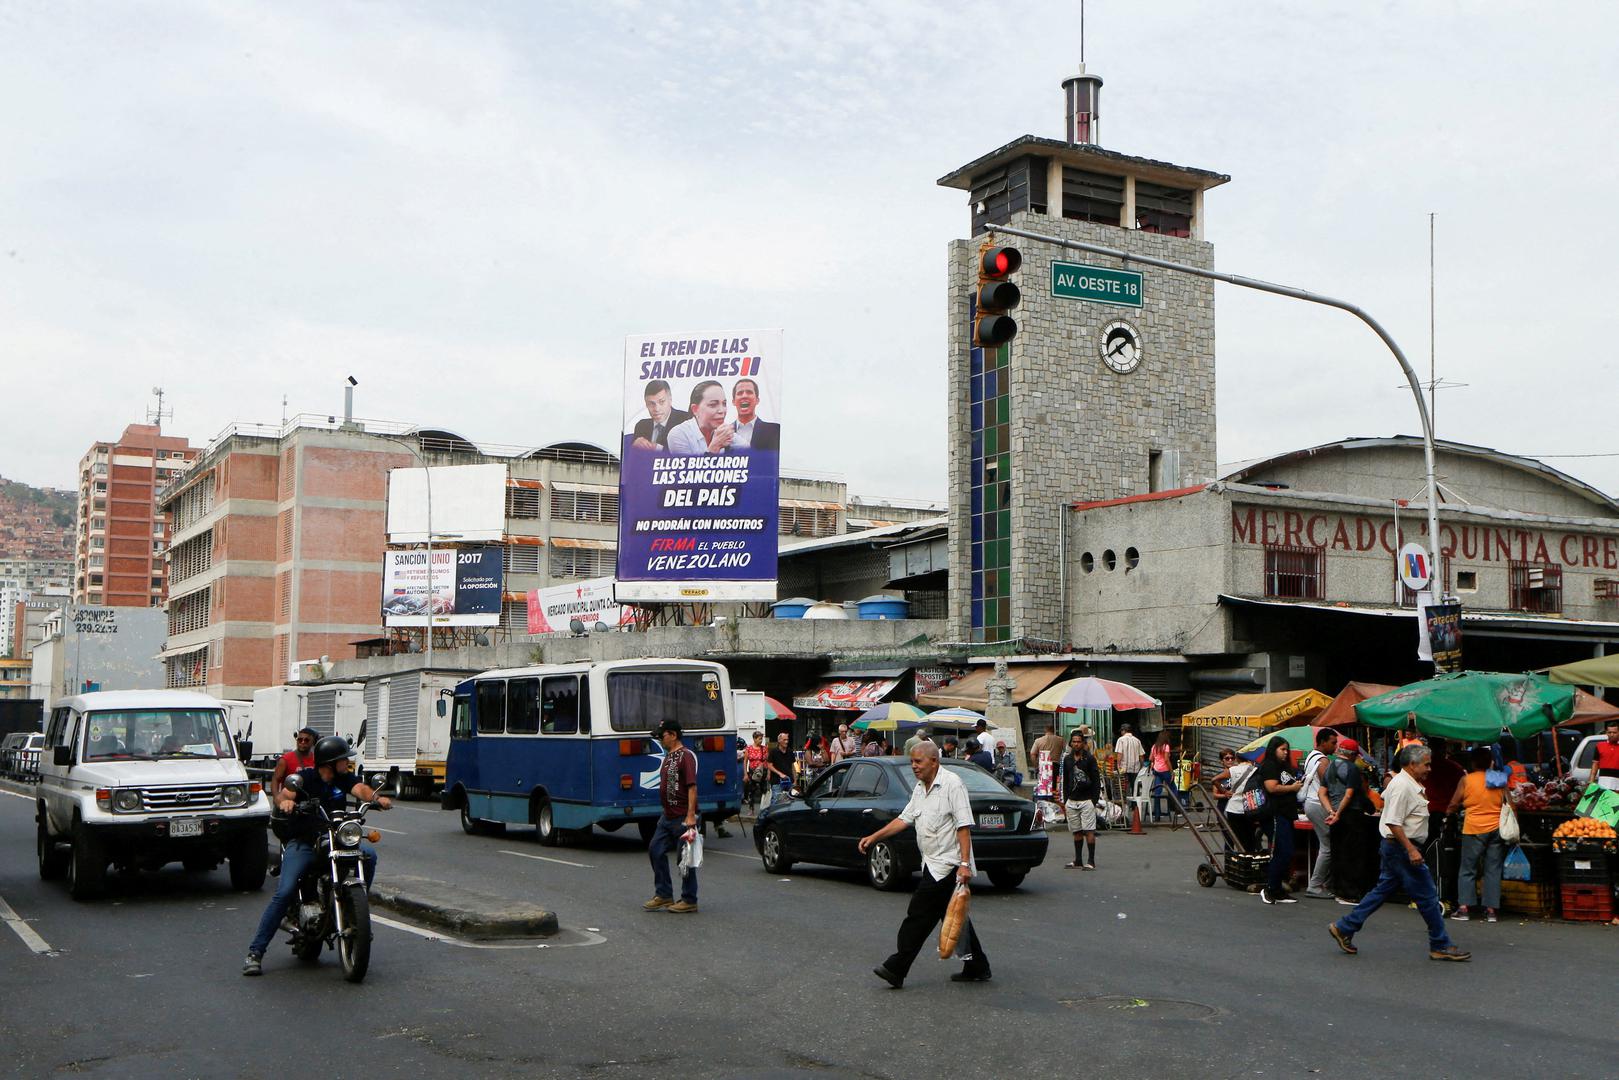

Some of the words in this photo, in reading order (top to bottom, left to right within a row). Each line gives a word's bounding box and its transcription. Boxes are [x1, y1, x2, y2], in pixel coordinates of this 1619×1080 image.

[1057, 273, 1076, 288] AV.
[1079, 276, 1121, 294] OESTE
[1124, 282, 1137, 296] 18
[640, 342, 656, 357] EL
[660, 340, 697, 356] TREN
[699, 339, 719, 354] DE
[721, 338, 749, 353] LAS
[639, 357, 741, 380] SANCIONES
[653, 457, 687, 470] ELLOS
[687, 456, 749, 469] BUSCARON
[652, 471, 677, 485] LAS
[677, 469, 749, 484] SANCIONES
[663, 489, 693, 507] DEL
[696, 485, 736, 506] PAÍS
[635, 520, 650, 531] NO
[651, 518, 692, 531] PODRÁN
[692, 519, 712, 530] CON
[712, 519, 764, 530] NOSOTROS
[1231, 507, 1404, 556] MERCADO
[650, 537, 697, 552] FIRMA
[697, 542, 709, 551] EL
[711, 540, 746, 550] PUEBLO
[395, 552, 427, 565] SANCIÓN
[430, 553, 450, 565] UNIO
[458, 553, 483, 564] 2017
[647, 552, 751, 571] VENEZOLANO
[547, 604, 566, 617] MERCADO
[567, 601, 589, 614] MUNICIPAL
[589, 598, 606, 612] QUINTA
[1274, 697, 1312, 722] MOTO
